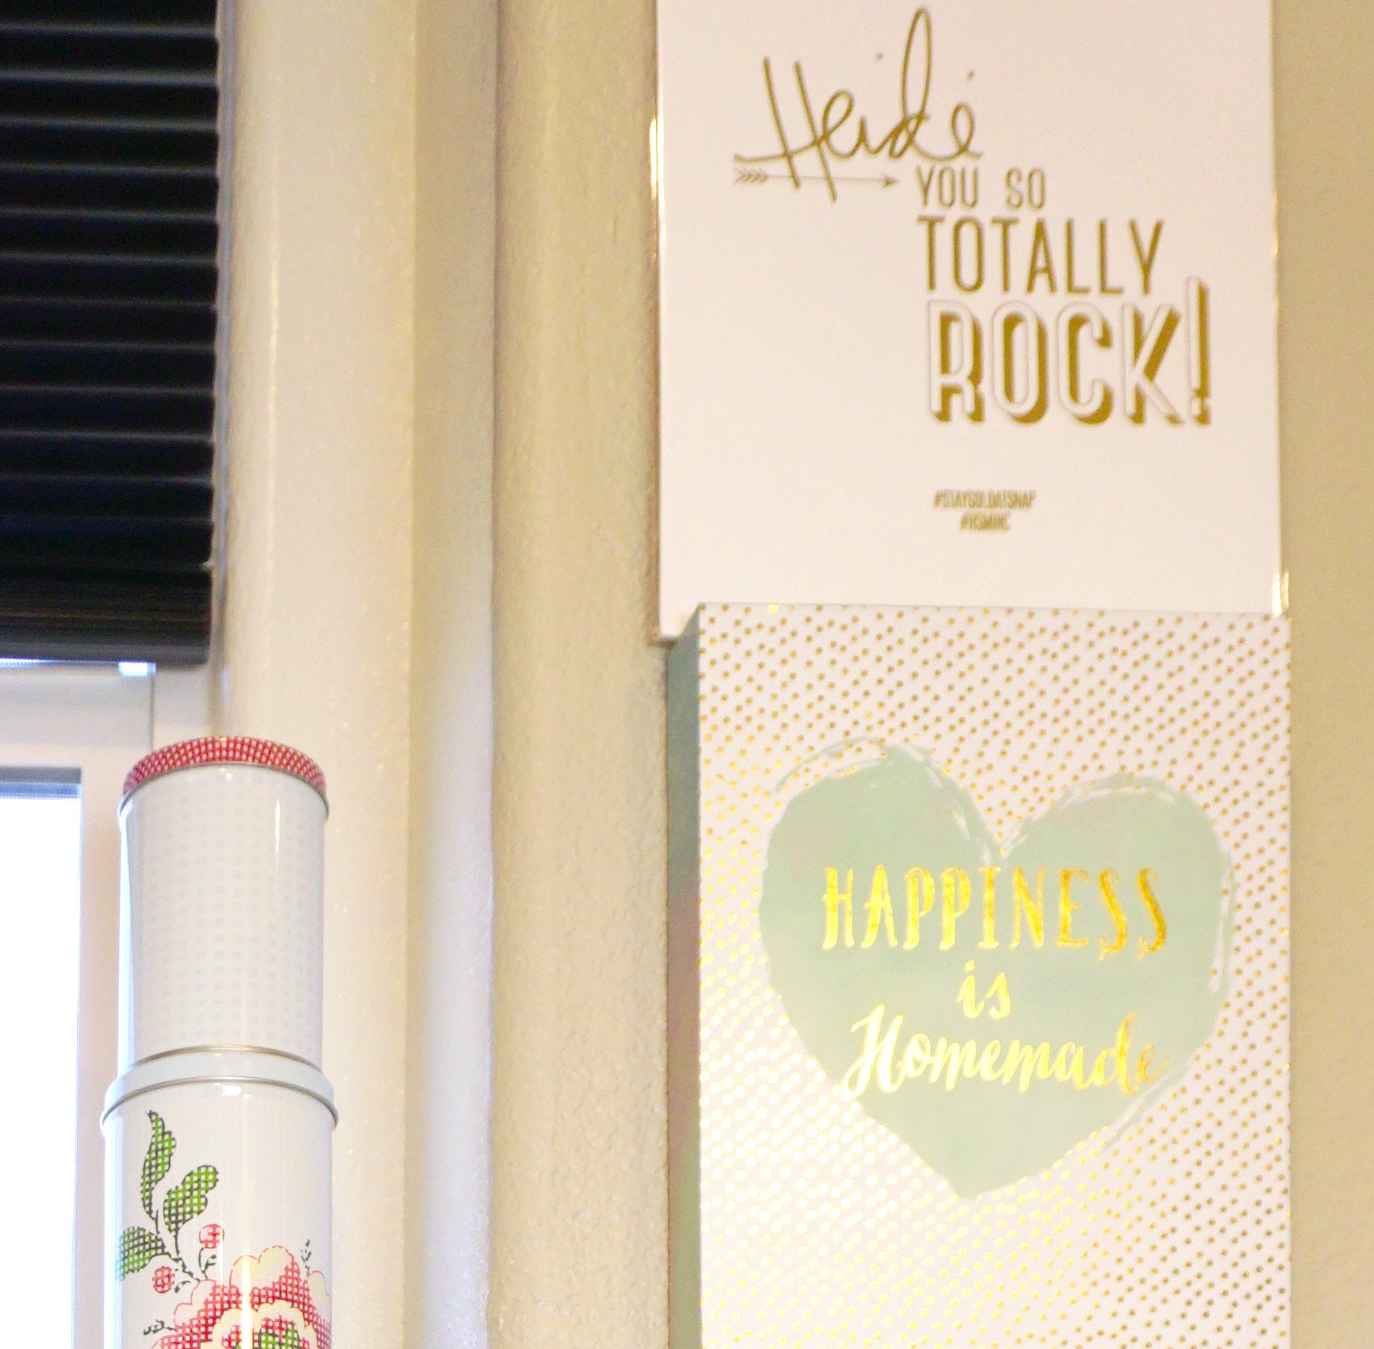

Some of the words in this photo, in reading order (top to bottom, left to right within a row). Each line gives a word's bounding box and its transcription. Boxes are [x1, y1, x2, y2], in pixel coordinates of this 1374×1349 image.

[916, 165, 978, 209] YOU
[1006, 168, 1046, 209] SO
[918, 215, 1163, 295] TOTALLY
[928, 277, 1210, 425] ROCK!
[822, 863, 1168, 959] HAPPINESS
[957, 960, 1012, 1020] is
[842, 1004, 1169, 1099] Homemade
